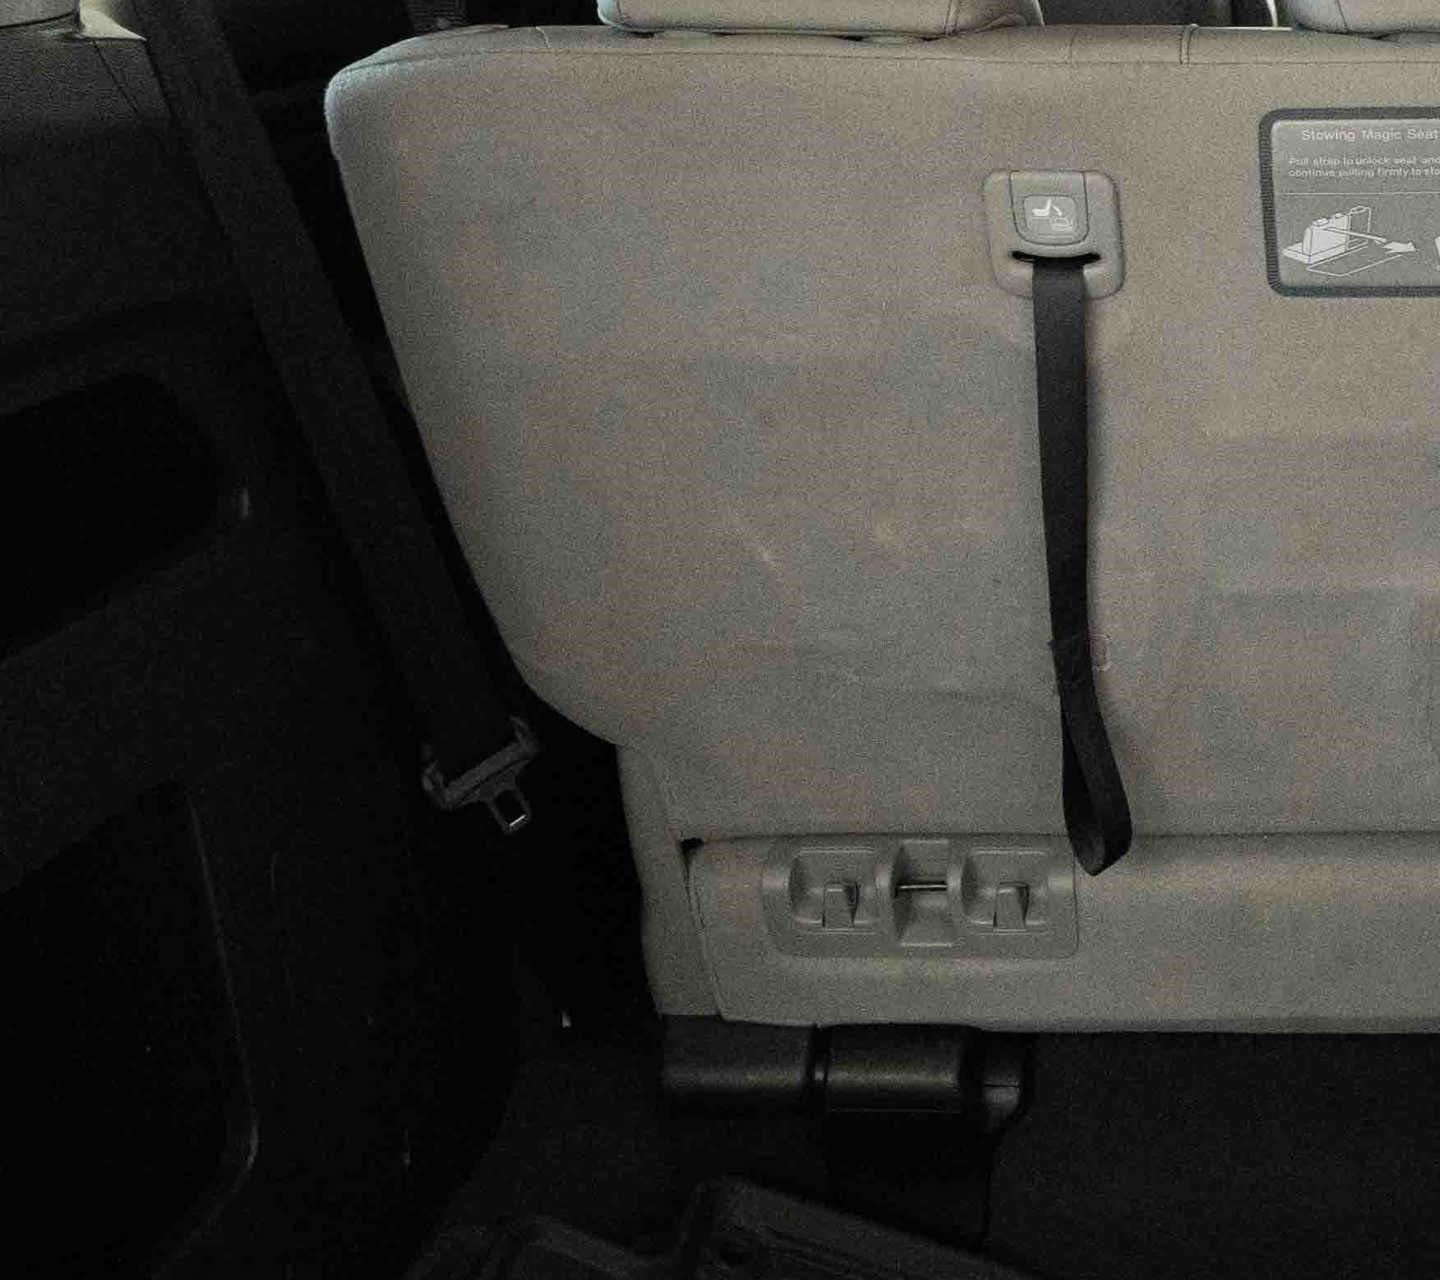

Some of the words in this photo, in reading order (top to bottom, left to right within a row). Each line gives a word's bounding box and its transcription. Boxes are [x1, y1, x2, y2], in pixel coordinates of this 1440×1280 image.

[1301, 129, 1356, 143] Stowing
[1361, 127, 1402, 142] Magic
[1407, 127, 1438, 140] Seat
